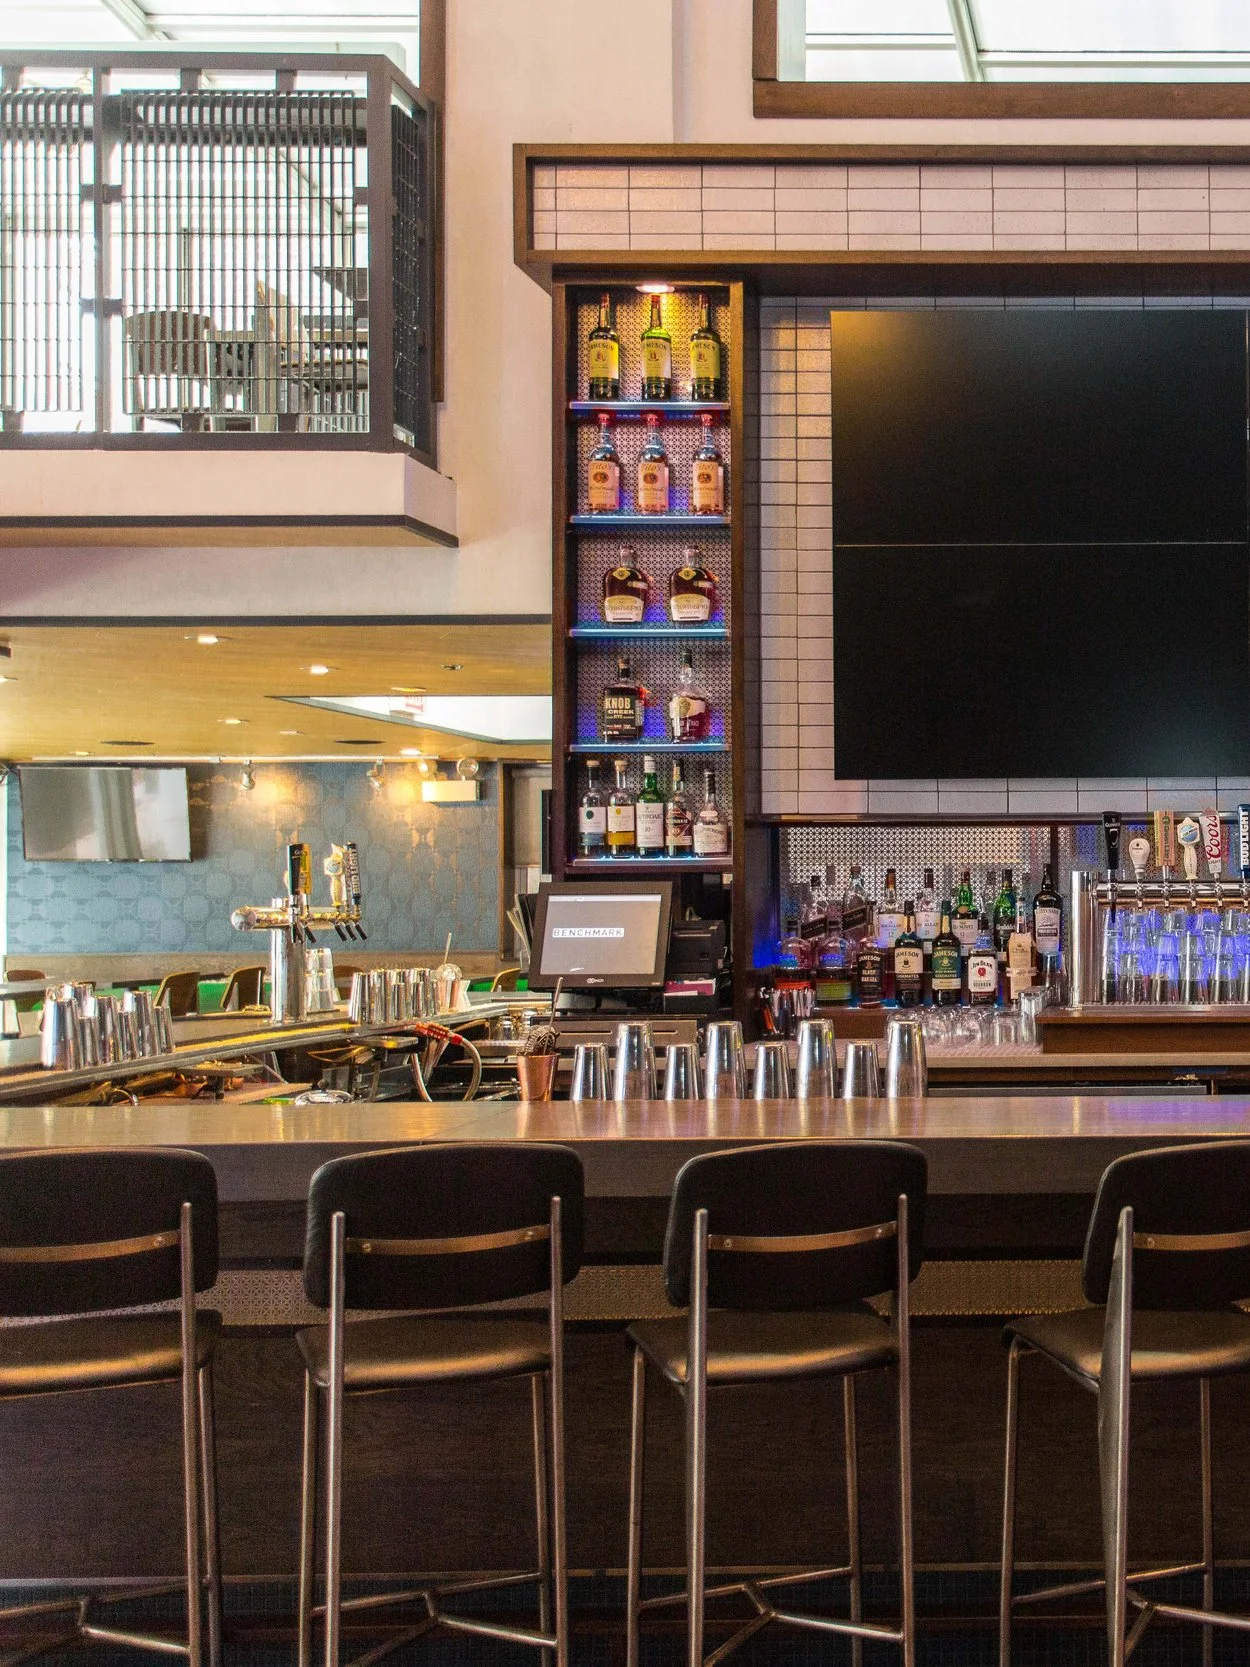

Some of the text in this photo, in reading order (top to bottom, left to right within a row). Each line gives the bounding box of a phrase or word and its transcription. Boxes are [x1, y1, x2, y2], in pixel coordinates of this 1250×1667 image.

[606, 698, 631, 709] KNOB
[1205, 815, 1221, 860] Coors
[1241, 811, 1250, 866] BUD LIGHT
[350, 849, 360, 894] BUD LIGHT
[553, 928, 623, 937] BENCHMARK
[971, 960, 993, 969] JIM BEAM
